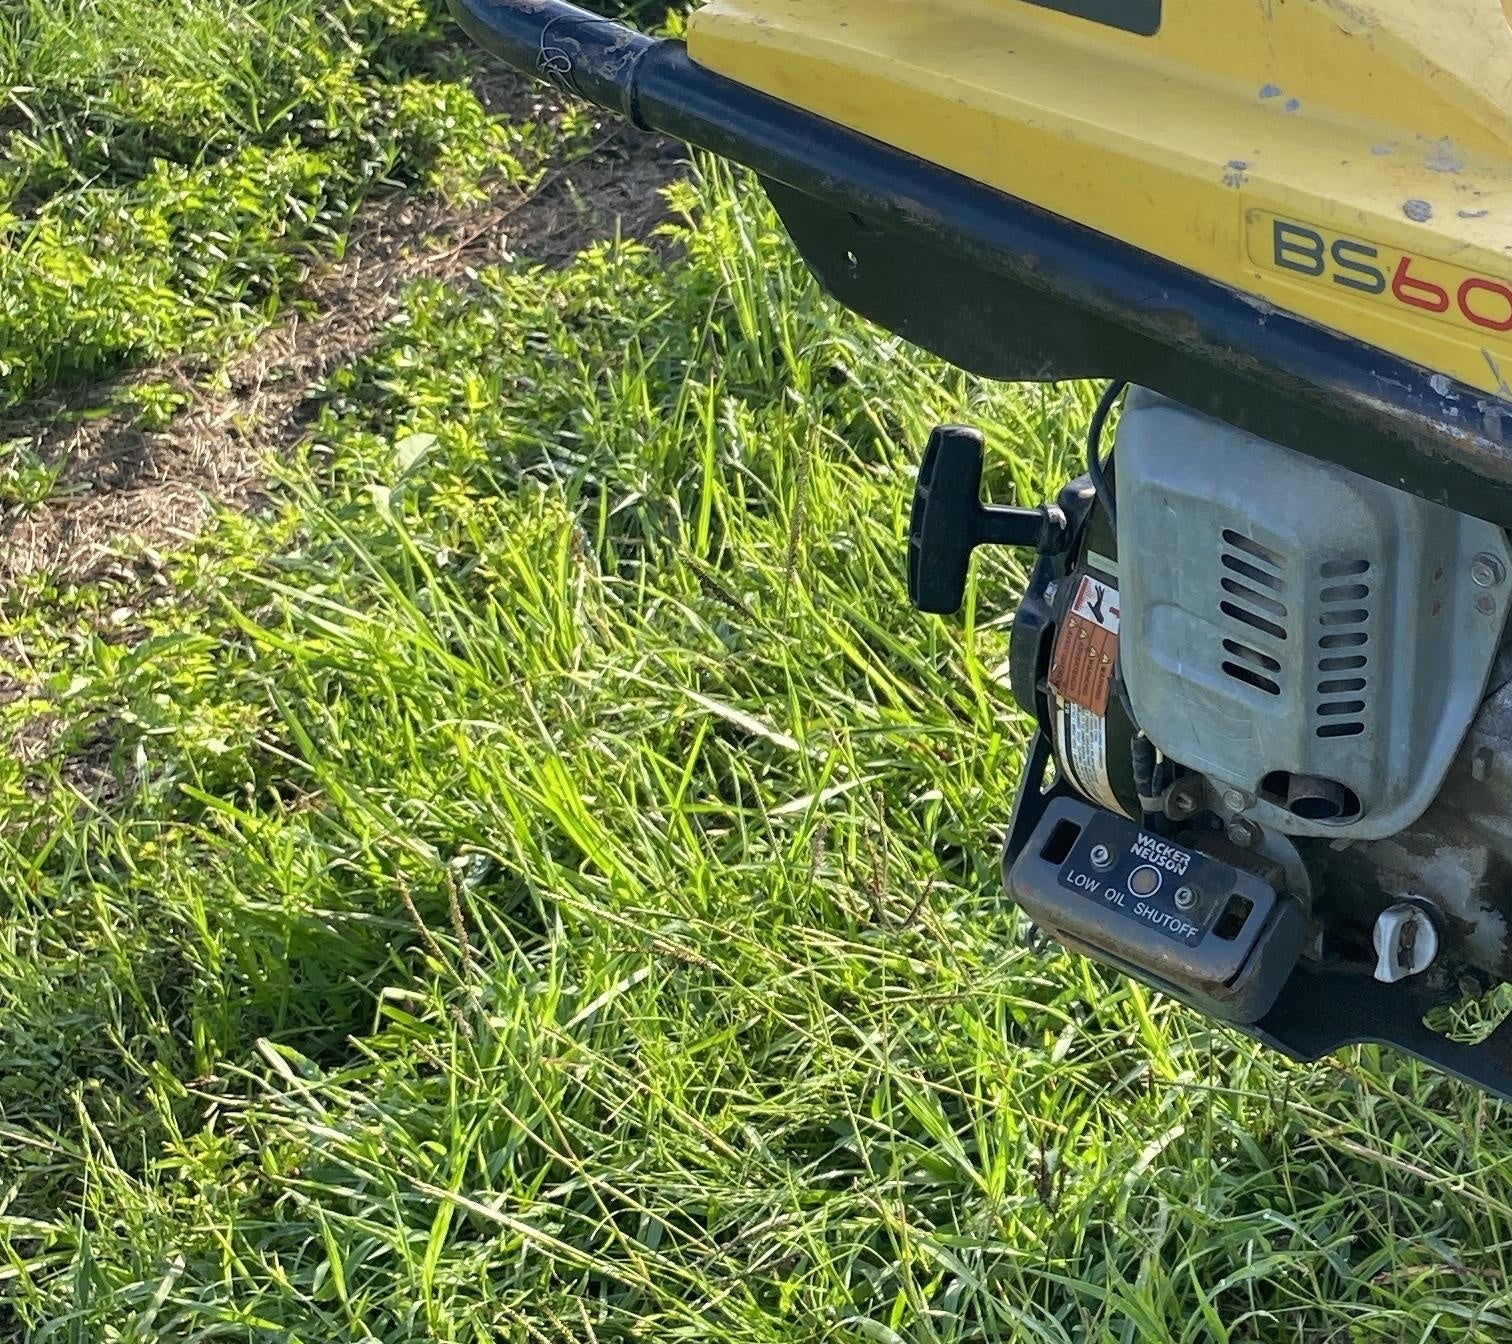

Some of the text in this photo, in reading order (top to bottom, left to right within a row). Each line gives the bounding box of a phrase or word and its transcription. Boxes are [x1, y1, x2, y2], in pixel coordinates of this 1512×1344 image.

[1130, 843, 1187, 876] NEUSON
[1137, 832, 1191, 867] WACKER
[1066, 870, 1100, 892] LOW
[1104, 887, 1126, 907] OIL
[1133, 902, 1199, 938] SHUTOFF
